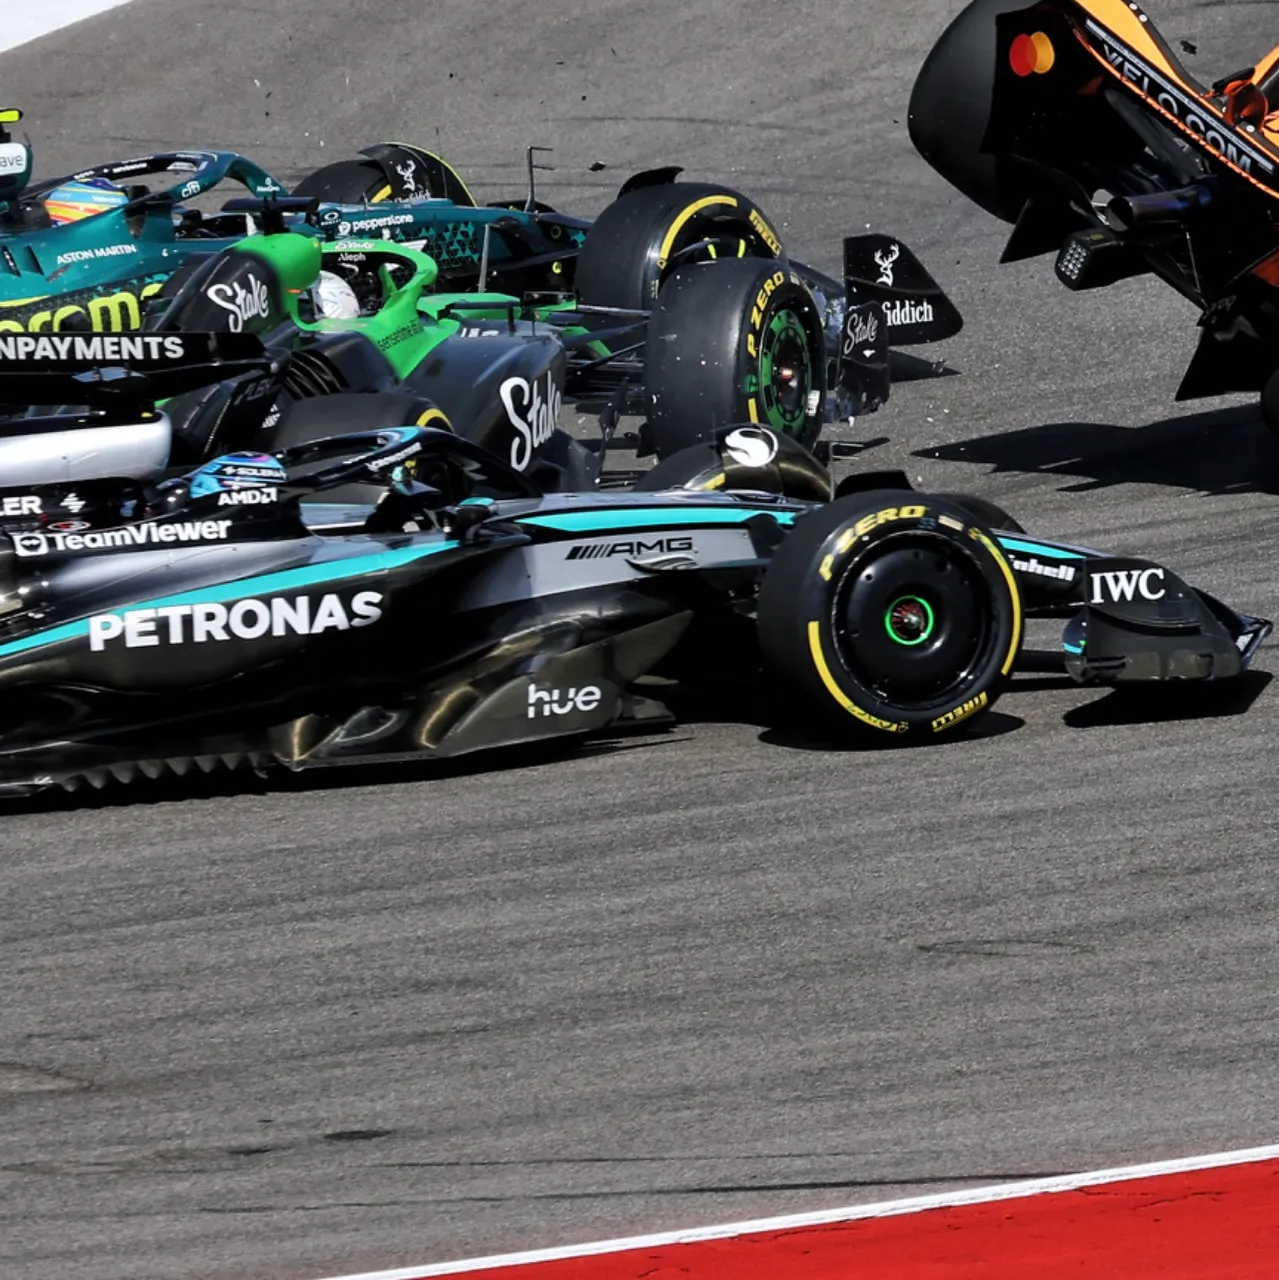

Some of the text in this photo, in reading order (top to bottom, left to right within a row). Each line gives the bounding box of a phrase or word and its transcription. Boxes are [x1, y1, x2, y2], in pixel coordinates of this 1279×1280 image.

[353, 213, 414, 232] pepperstone
[56, 243, 137, 265] ASTON MARTIN
[207, 272, 269, 332] Stake
[750, 270, 785, 331] ZERO
[0, 336, 184, 360] NPAYMENTS
[843, 311, 879, 355] Stake
[500, 370, 562, 472] Stake
[0, 496, 43, 516] ER
[218, 489, 262, 506] AMD
[48, 519, 233, 551] TeamViewer
[606, 536, 693, 558] AMG
[818, 505, 928, 581] P ZERO
[1090, 568, 1166, 604] IWC
[88, 591, 383, 652] PETRONAS
[526, 682, 602, 719] hue
